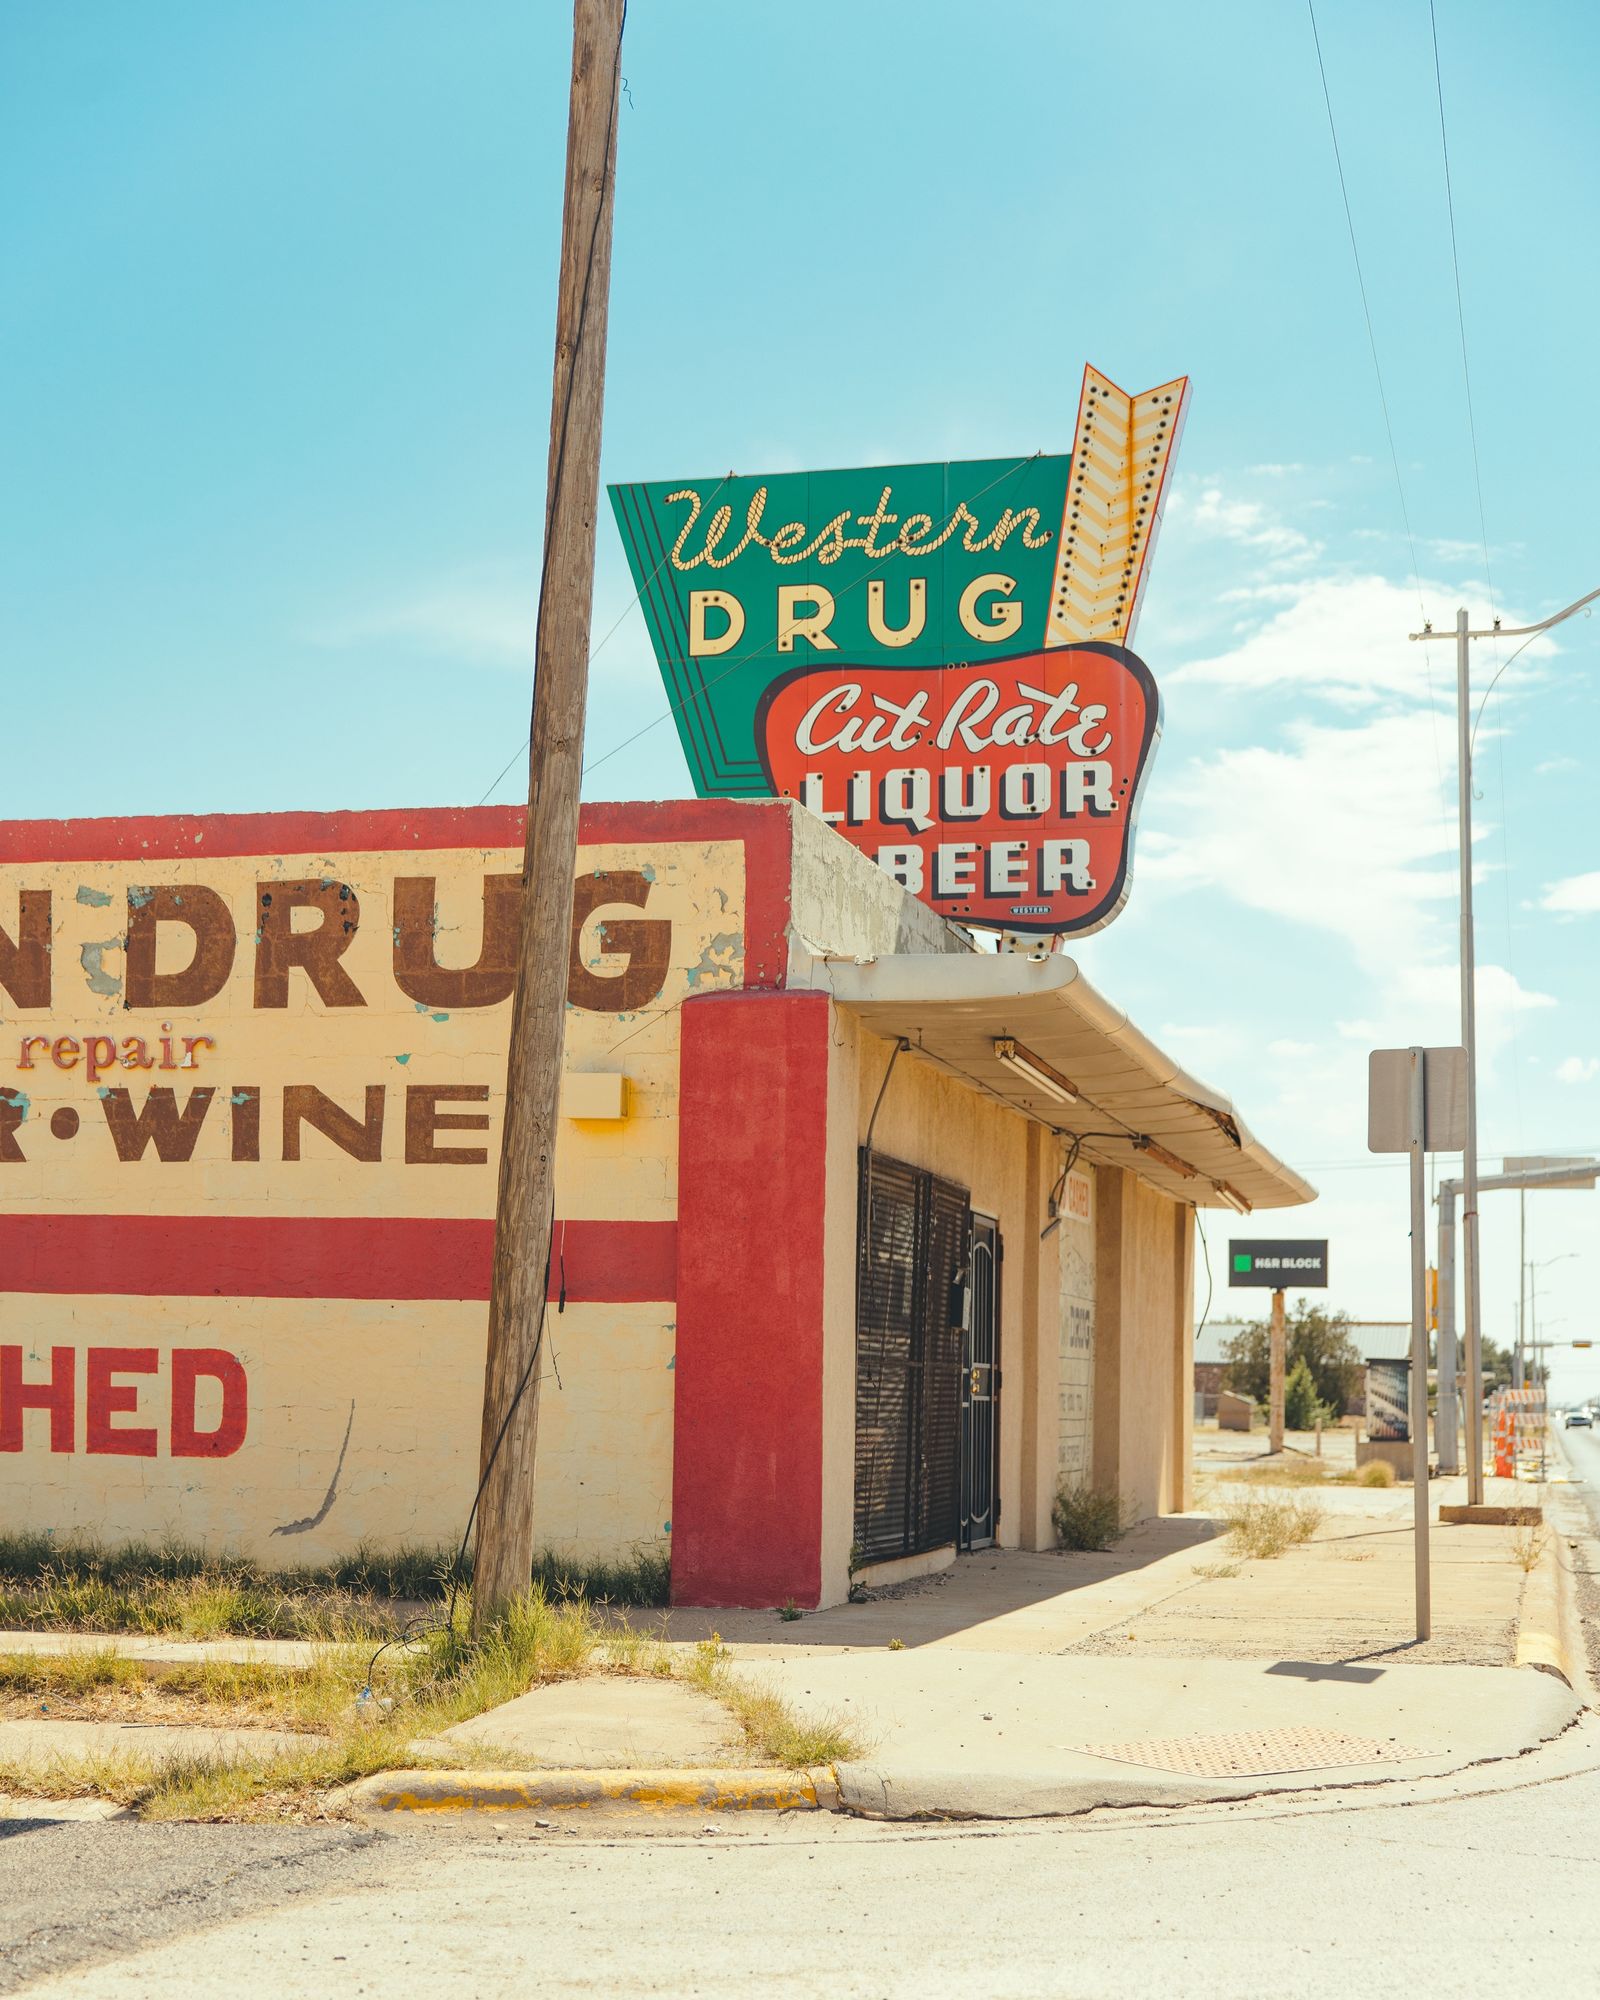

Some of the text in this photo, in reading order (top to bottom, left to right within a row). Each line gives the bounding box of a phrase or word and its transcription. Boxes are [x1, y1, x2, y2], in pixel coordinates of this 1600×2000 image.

[664, 486, 1053, 571] Western
[688, 572, 1024, 657] DRUG
[795, 679, 1113, 757] Cut Rate
[803, 760, 1119, 833] LIQUOR
[874, 838, 1096, 896] BEER
[125, 870, 672, 1013] DRUG
[16, 1020, 214, 1083] repair
[1254, 1257, 1321, 1269] H&R BLOCK
